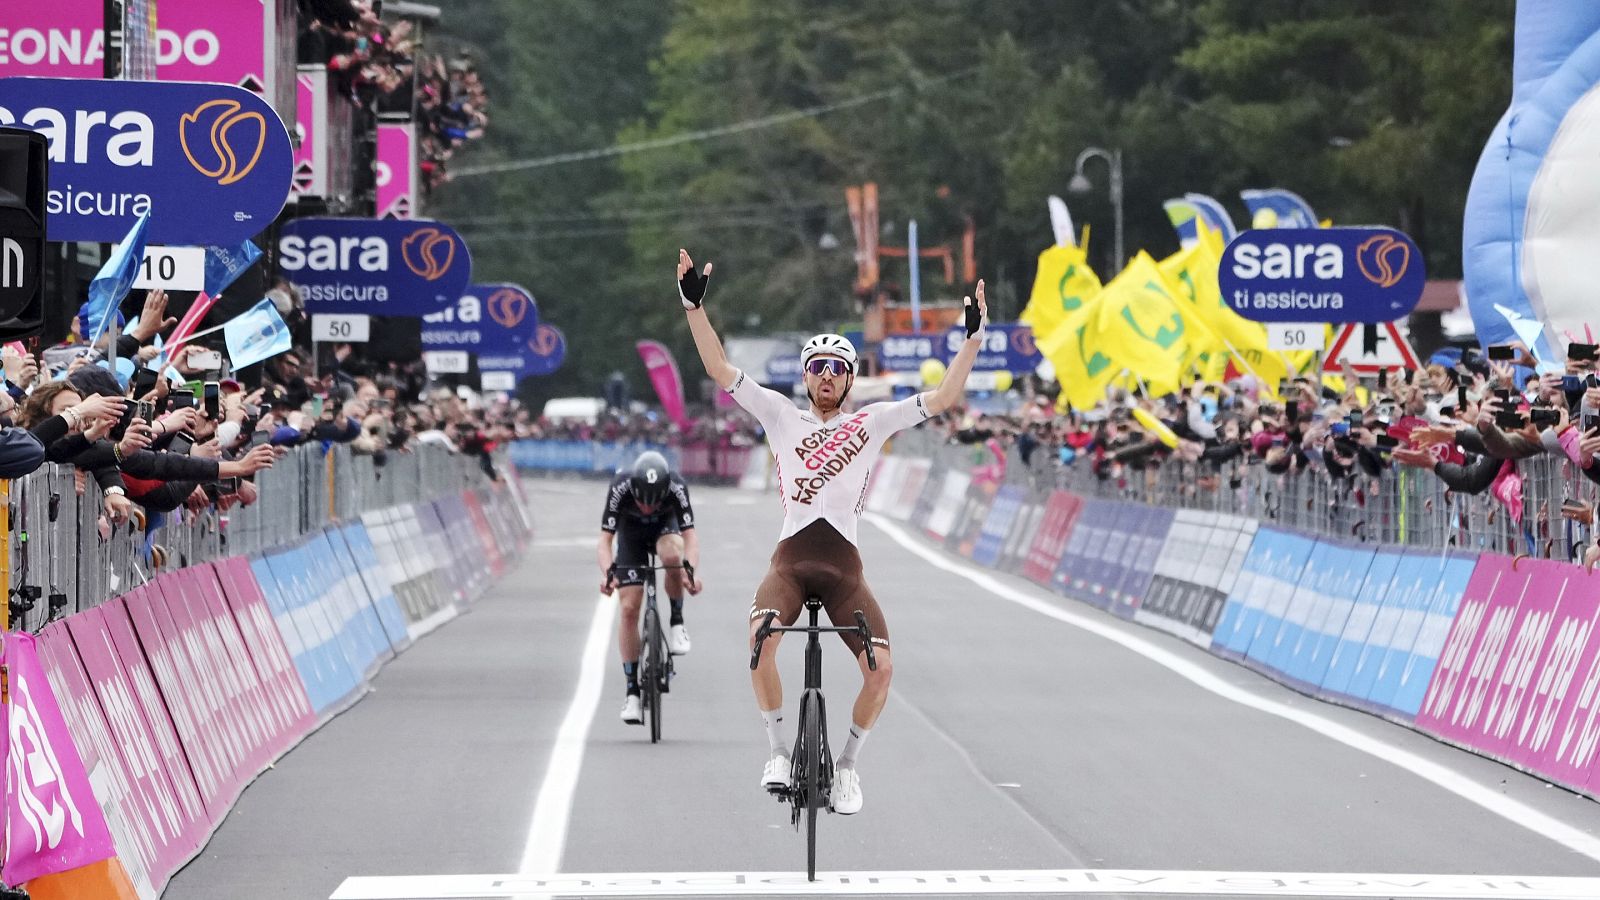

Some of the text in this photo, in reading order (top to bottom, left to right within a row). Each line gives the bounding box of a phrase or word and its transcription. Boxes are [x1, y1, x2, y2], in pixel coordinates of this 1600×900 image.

[279, 235, 389, 271] sara
[1232, 243, 1343, 279] sara
[142, 255, 176, 281] 10
[1233, 289, 1344, 309] ti assicura
[328, 321, 351, 337] 50
[1284, 329, 1306, 346] 50
[799, 427, 870, 505] MONDIALE
[791, 477, 811, 502] LA
